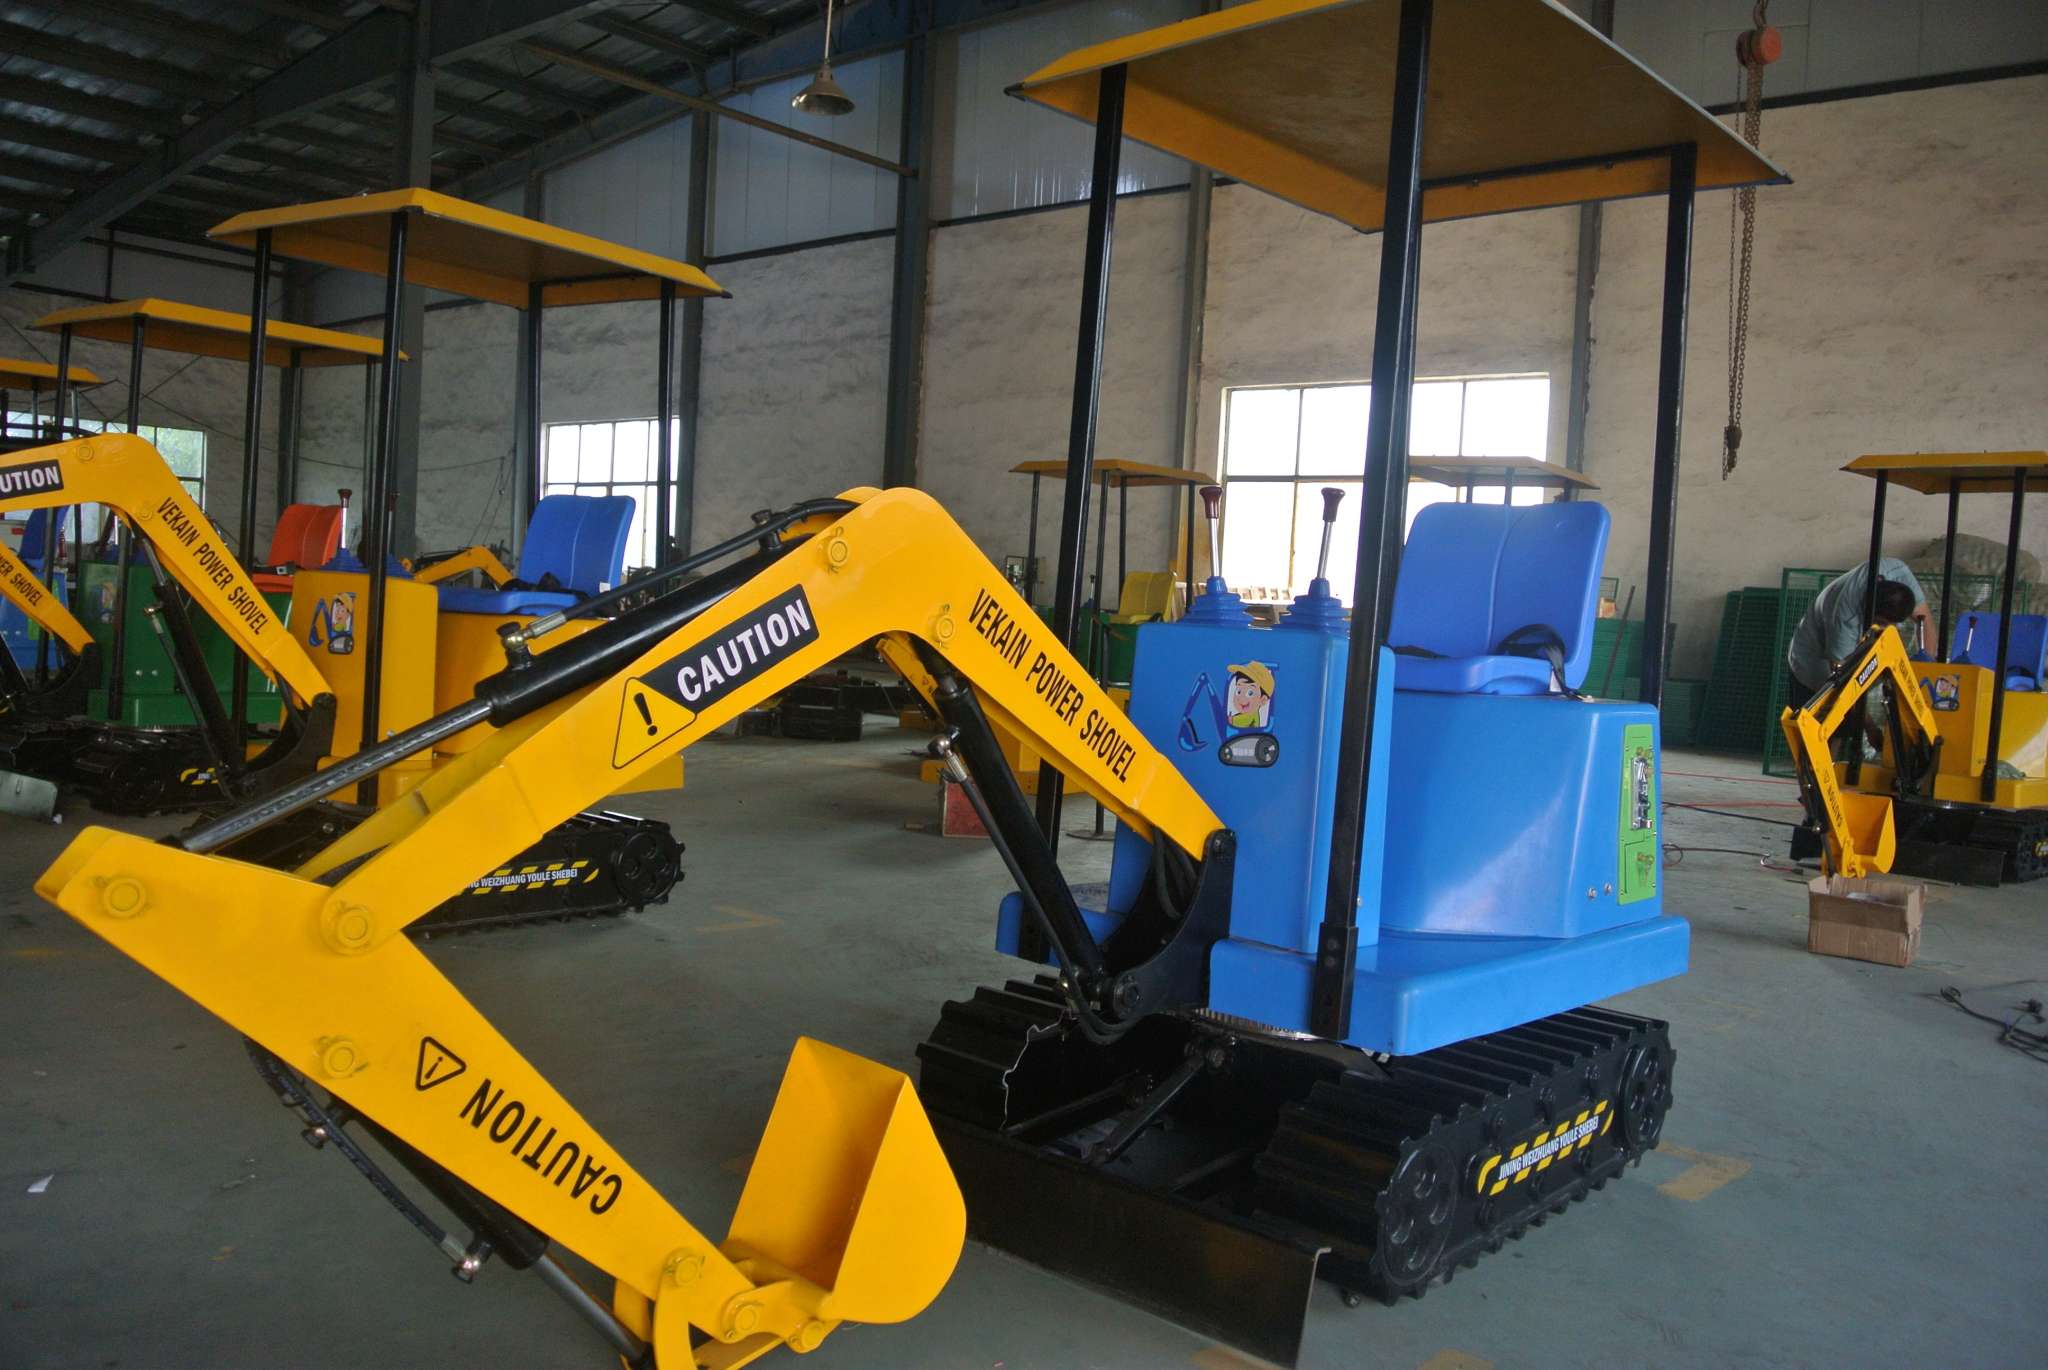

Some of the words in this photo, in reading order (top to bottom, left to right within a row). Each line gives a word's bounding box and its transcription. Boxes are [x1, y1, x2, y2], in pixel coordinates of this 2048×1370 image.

[10, 573, 42, 606] SHOVEL
[157, 497, 200, 547] VEKAIN
[193, 543, 234, 591] POWER
[228, 586, 268, 635] SHOVEL
[677, 599, 811, 701] CAUTION
[968, 588, 1032, 669] VEKAIN
[1025, 652, 1085, 726] POWER
[1080, 709, 1136, 783] SHOVEL
[481, 874, 526, 887] WEIZHUANG
[527, 871, 551, 882] YOULE
[551, 868, 578, 880] SHEBEI
[459, 1078, 622, 1215] CAUTION
[1499, 1157, 1521, 1180] JINING
[1522, 1137, 1559, 1169] WEIZHUANG
[1560, 1127, 1578, 1149] YOULE
[1578, 1115, 1599, 1138] SHEBEI
